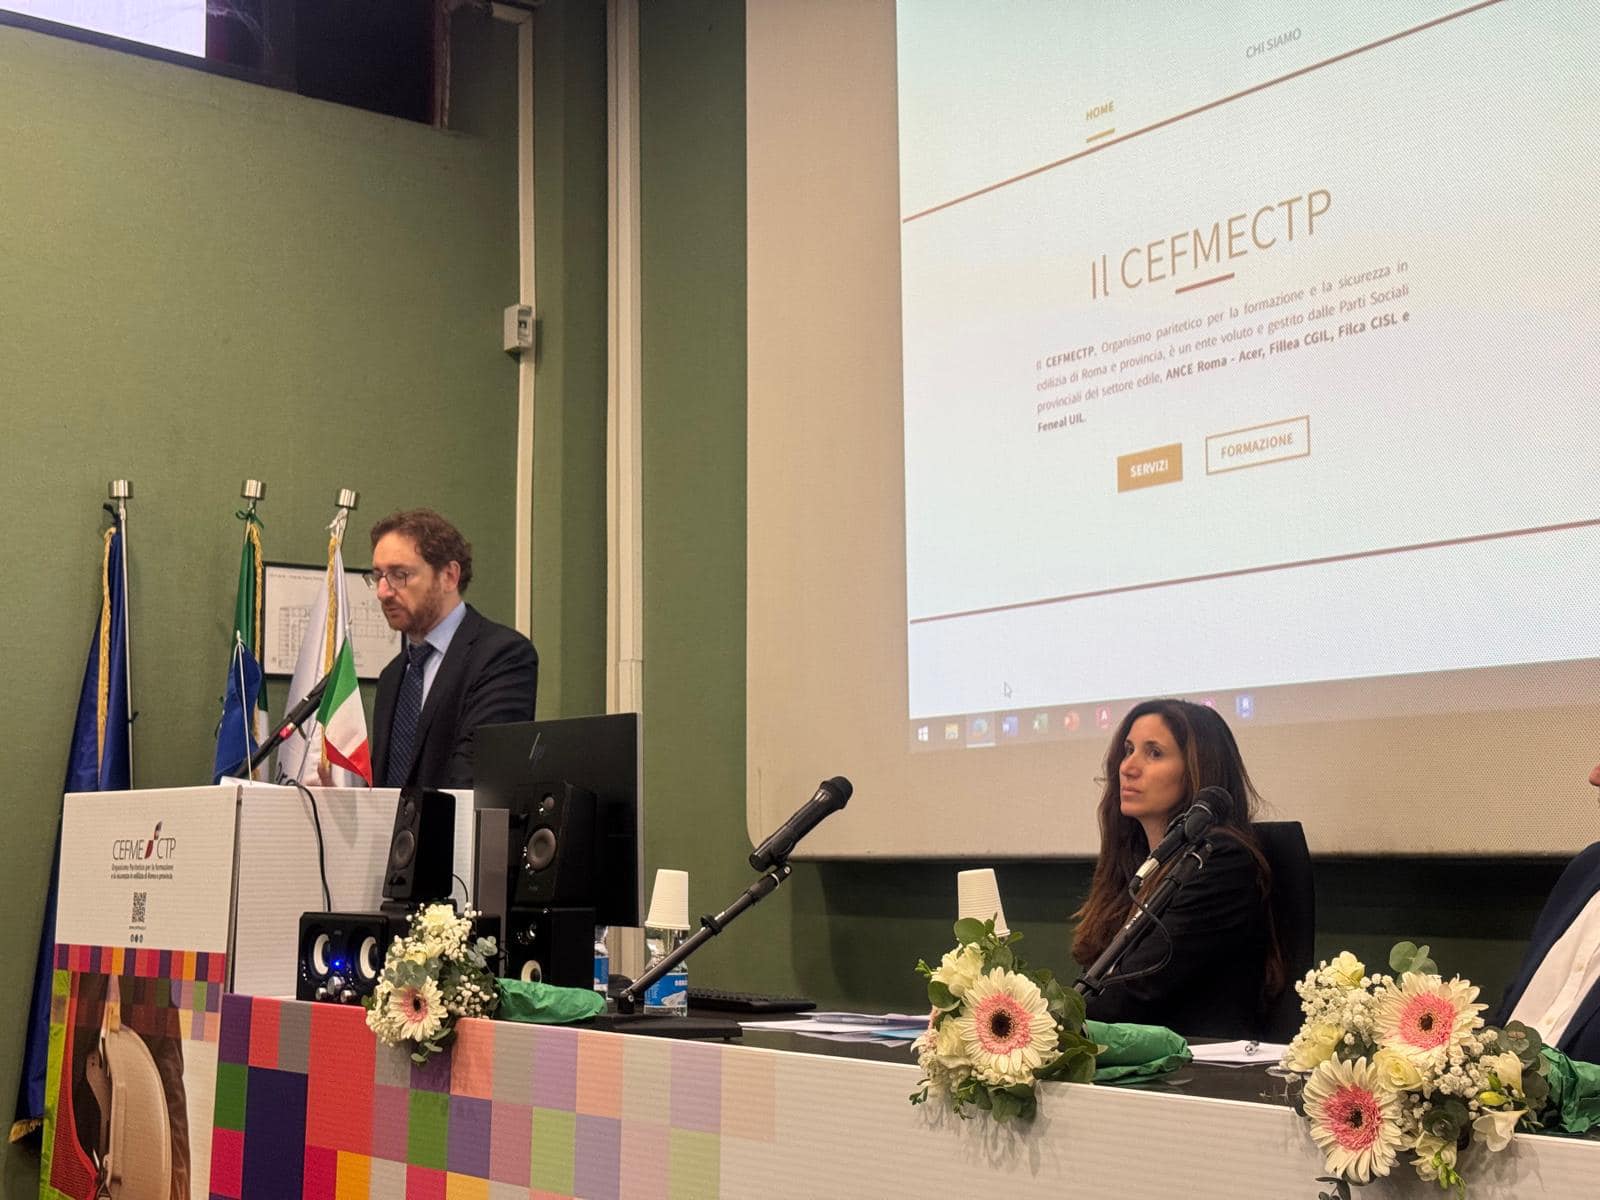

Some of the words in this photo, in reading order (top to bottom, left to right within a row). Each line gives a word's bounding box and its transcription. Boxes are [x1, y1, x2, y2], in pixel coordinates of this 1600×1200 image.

[1246, 41, 1265, 58] CHI
[1267, 27, 1302, 51] SIAMO
[1085, 100, 1115, 122] HOME
[1091, 253, 1109, 300] Il
[1120, 188, 1331, 289] CEFMECTP
[1101, 331, 1152, 354] Organismo
[1156, 318, 1202, 341] paritetico
[1207, 311, 1224, 327] per
[1229, 307, 1239, 318] la
[1244, 289, 1304, 315] formazione
[1311, 286, 1317, 294] e
[1322, 281, 1333, 293] la
[1338, 264, 1391, 289] sicurezza
[1397, 260, 1408, 273] in
[1036, 373, 1067, 391] edilizia
[1070, 371, 1079, 383] di
[1081, 366, 1107, 380] Roma
[1111, 364, 1117, 372] e
[1178, 343, 1192, 354] un
[1195, 335, 1217, 350] ente
[1220, 327, 1253, 344] voluto
[1257, 324, 1264, 333] e
[1268, 313, 1303, 334] gestito
[1307, 304, 1335, 321] dalle
[1339, 296, 1366, 313] Parti
[1370, 283, 1409, 304] Sociali
[1037, 392, 1083, 414] provinciali
[1102, 380, 1134, 396] settore
[1165, 363, 1193, 380] ANCE
[1197, 356, 1227, 372] Roma
[1238, 347, 1266, 363] Acer,
[1269, 338, 1300, 355] Fillea
[1303, 329, 1335, 347] CGIL,
[1338, 321, 1366, 338] Filca
[1370, 313, 1398, 331] CISL
[1402, 311, 1410, 322] e
[1037, 416, 1067, 433] Feneal
[1220, 432, 1294, 460] FORMAZIONE
[1129, 459, 1169, 478] SERVIZI
[112, 839, 144, 860] CEFME
[157, 837, 176, 859] CTP
